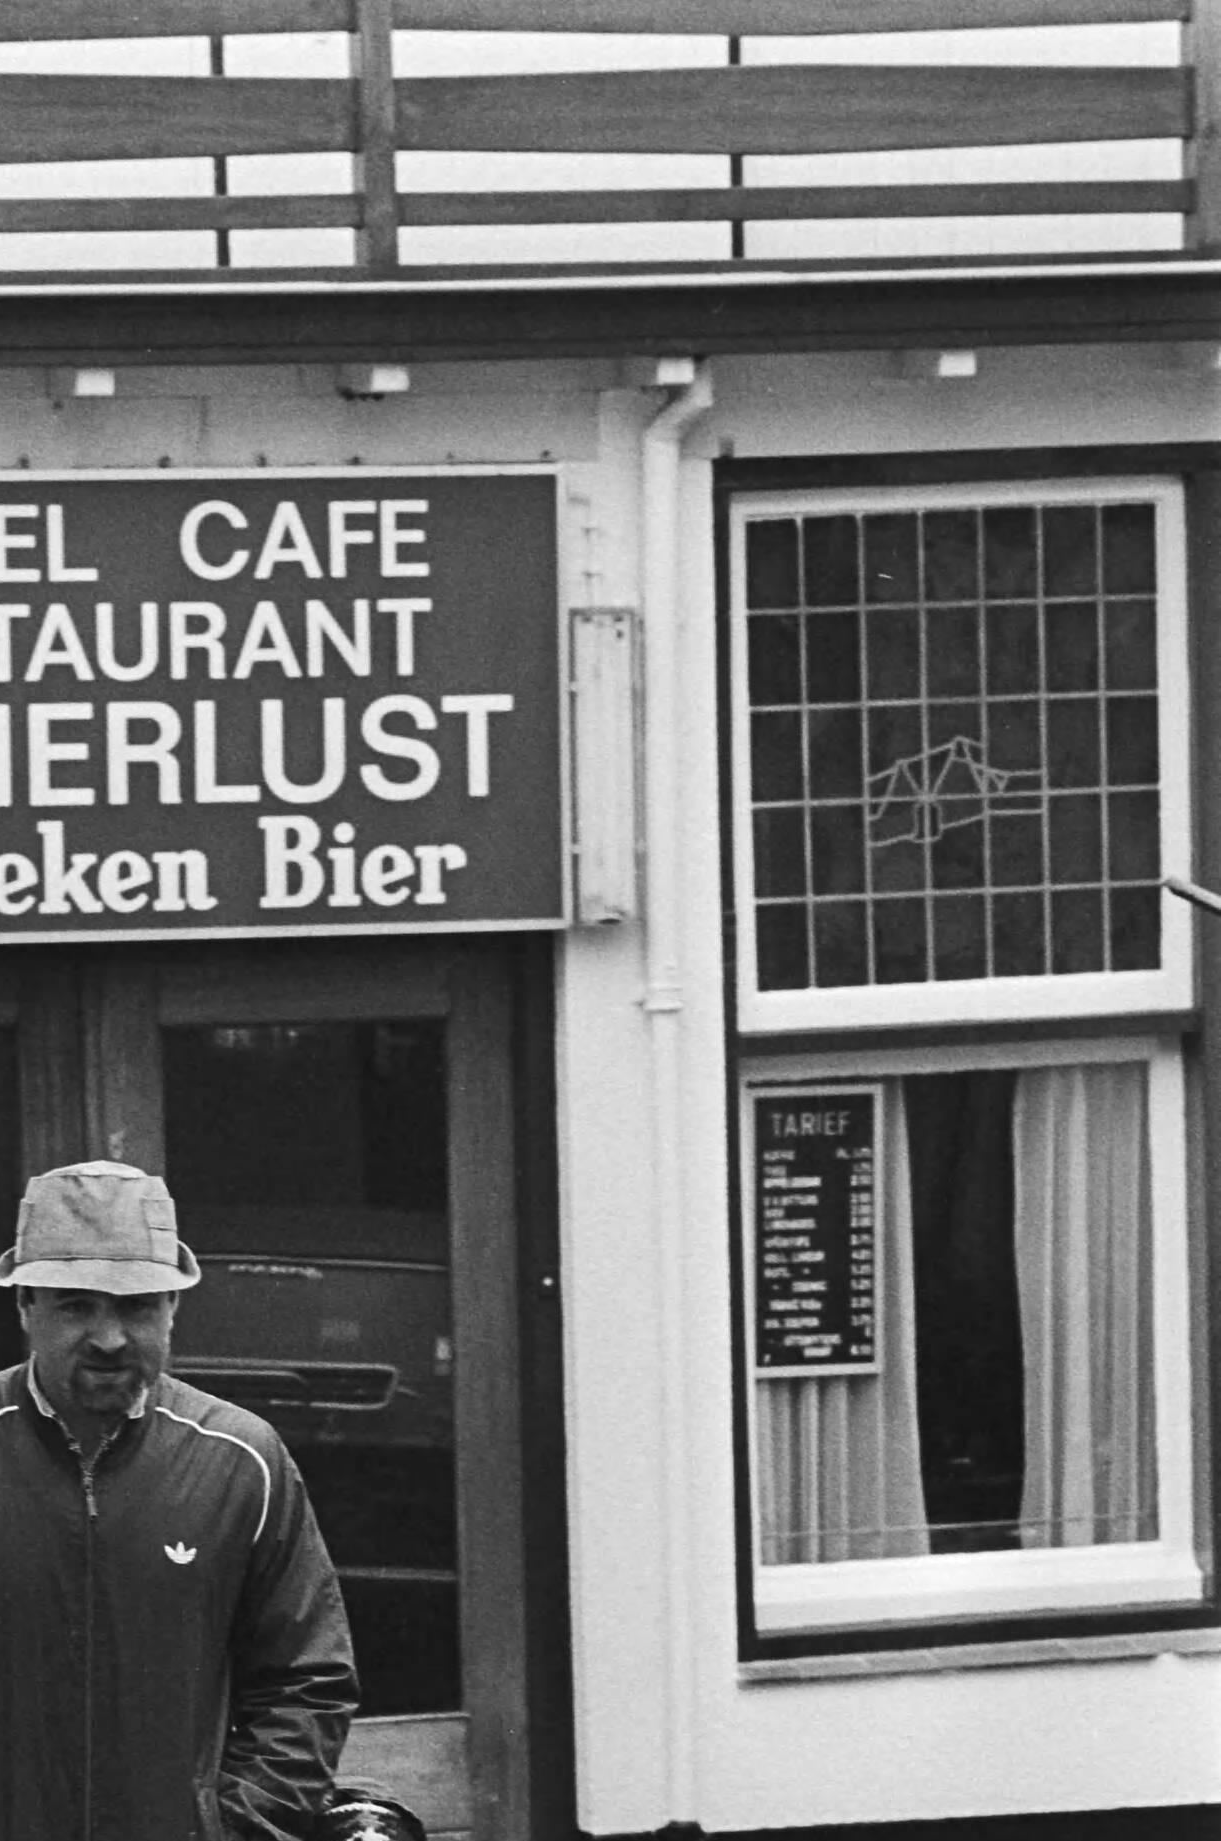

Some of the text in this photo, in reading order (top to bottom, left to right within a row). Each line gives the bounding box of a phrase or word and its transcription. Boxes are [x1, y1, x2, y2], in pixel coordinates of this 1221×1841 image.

[179, 499, 430, 580] CAFE
[259, 814, 468, 909] Bier
[771, 1111, 851, 1138] TARIEF
